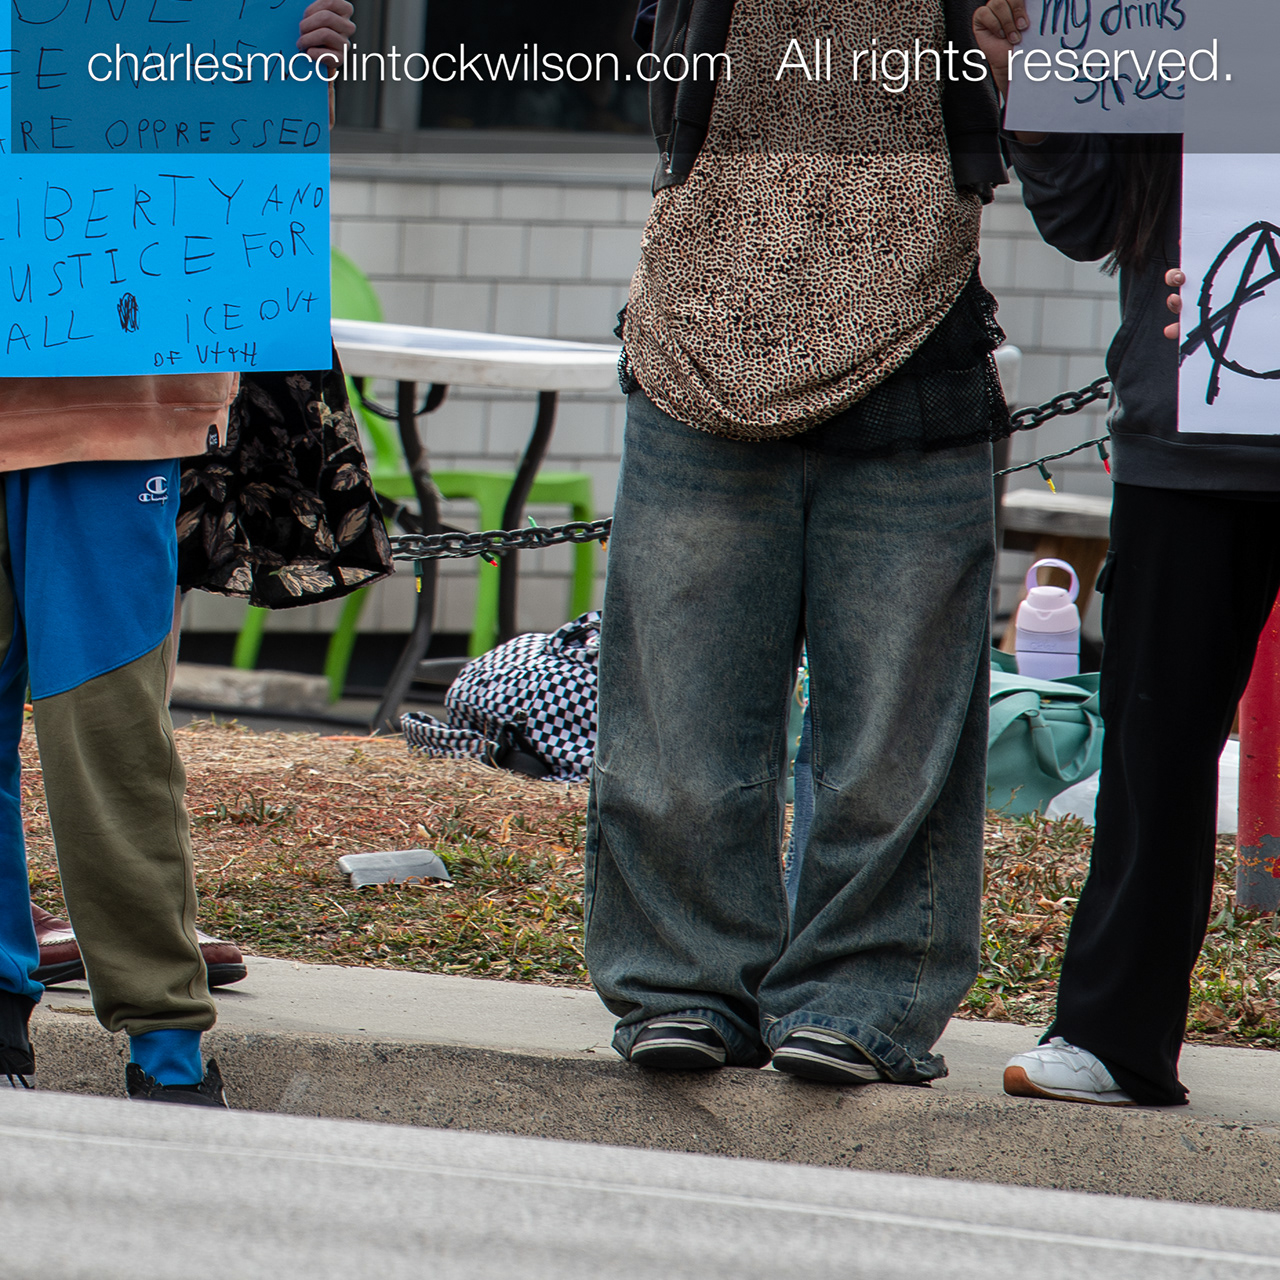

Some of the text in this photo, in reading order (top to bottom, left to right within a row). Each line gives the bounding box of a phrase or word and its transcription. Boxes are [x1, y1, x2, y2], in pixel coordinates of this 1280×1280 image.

[105, 118, 322, 150] OPPRESSED
[261, 182, 324, 217] AND
[6, 309, 95, 355] ALL
